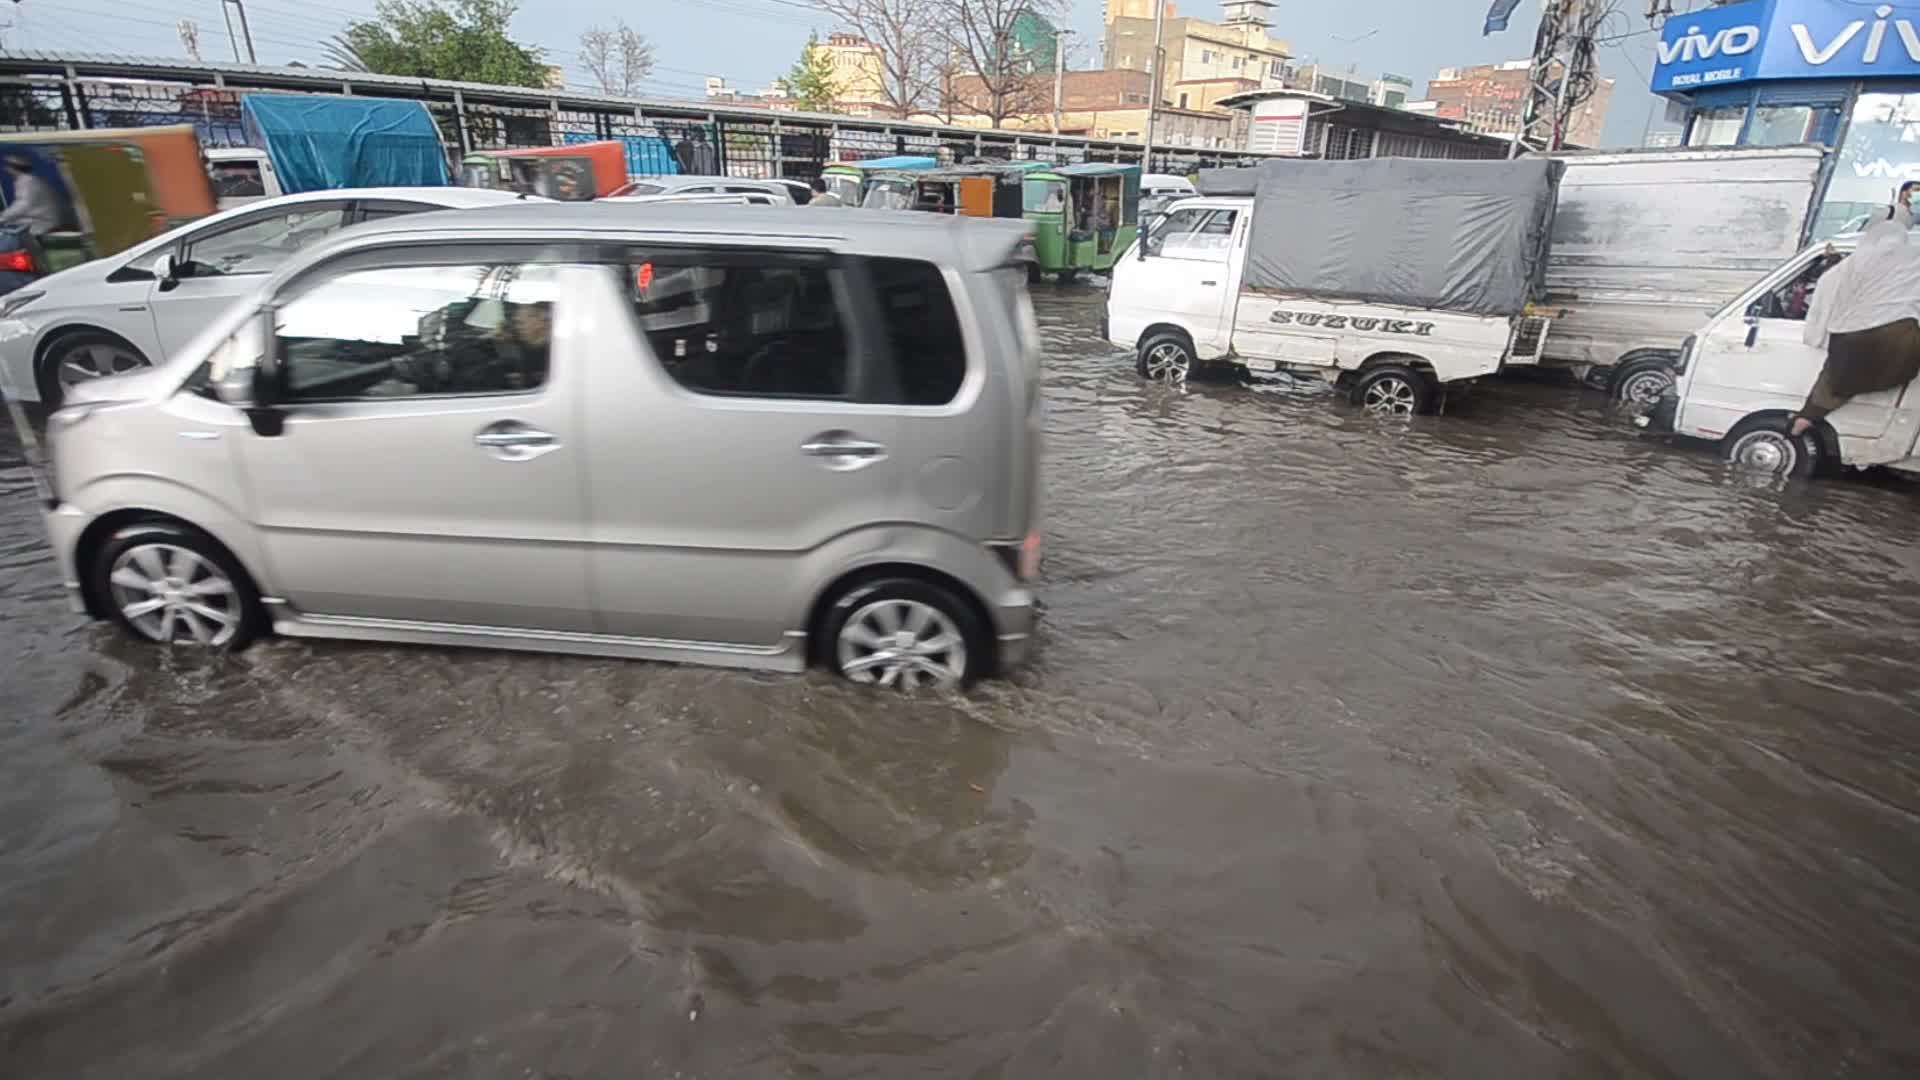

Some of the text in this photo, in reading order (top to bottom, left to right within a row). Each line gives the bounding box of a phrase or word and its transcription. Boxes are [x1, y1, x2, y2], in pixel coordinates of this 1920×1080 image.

[1657, 26, 1760, 65] vivo
[1704, 67, 1742, 81] MOBILE
[1269, 310, 1435, 336] SUZUKI
